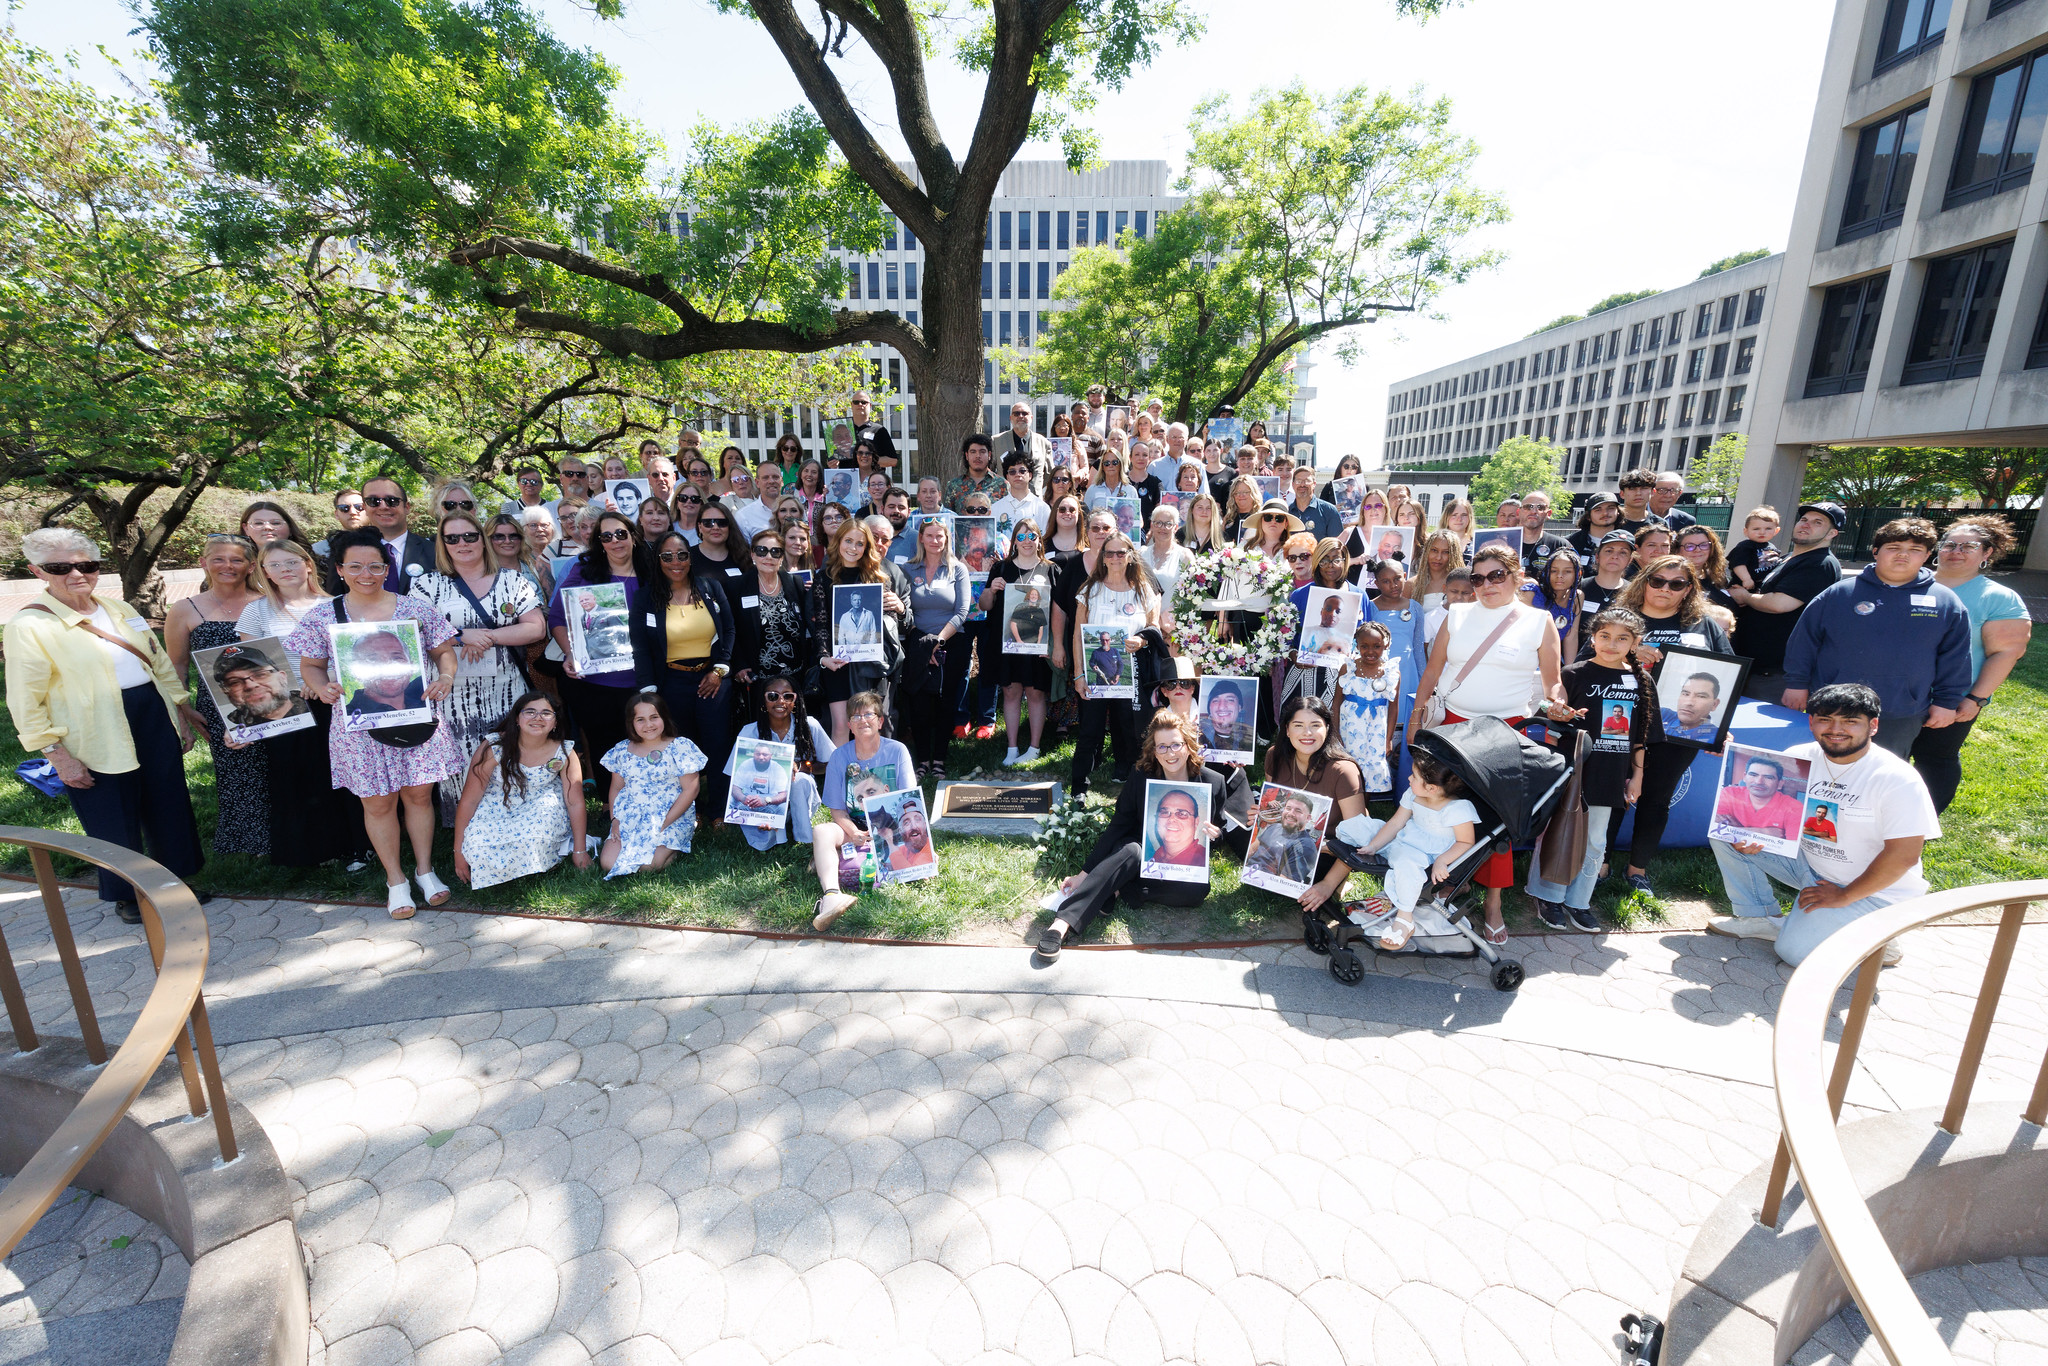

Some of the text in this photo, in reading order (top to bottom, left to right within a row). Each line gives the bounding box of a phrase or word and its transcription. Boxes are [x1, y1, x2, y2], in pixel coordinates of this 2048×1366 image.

[249, 725, 270, 733] Patrick
[272, 720, 293, 728] Archer,
[1726, 827, 1752, 837] Alejandro
[1752, 834, 1775, 844] Romero,
[1823, 845, 1845, 855] ROMERO
